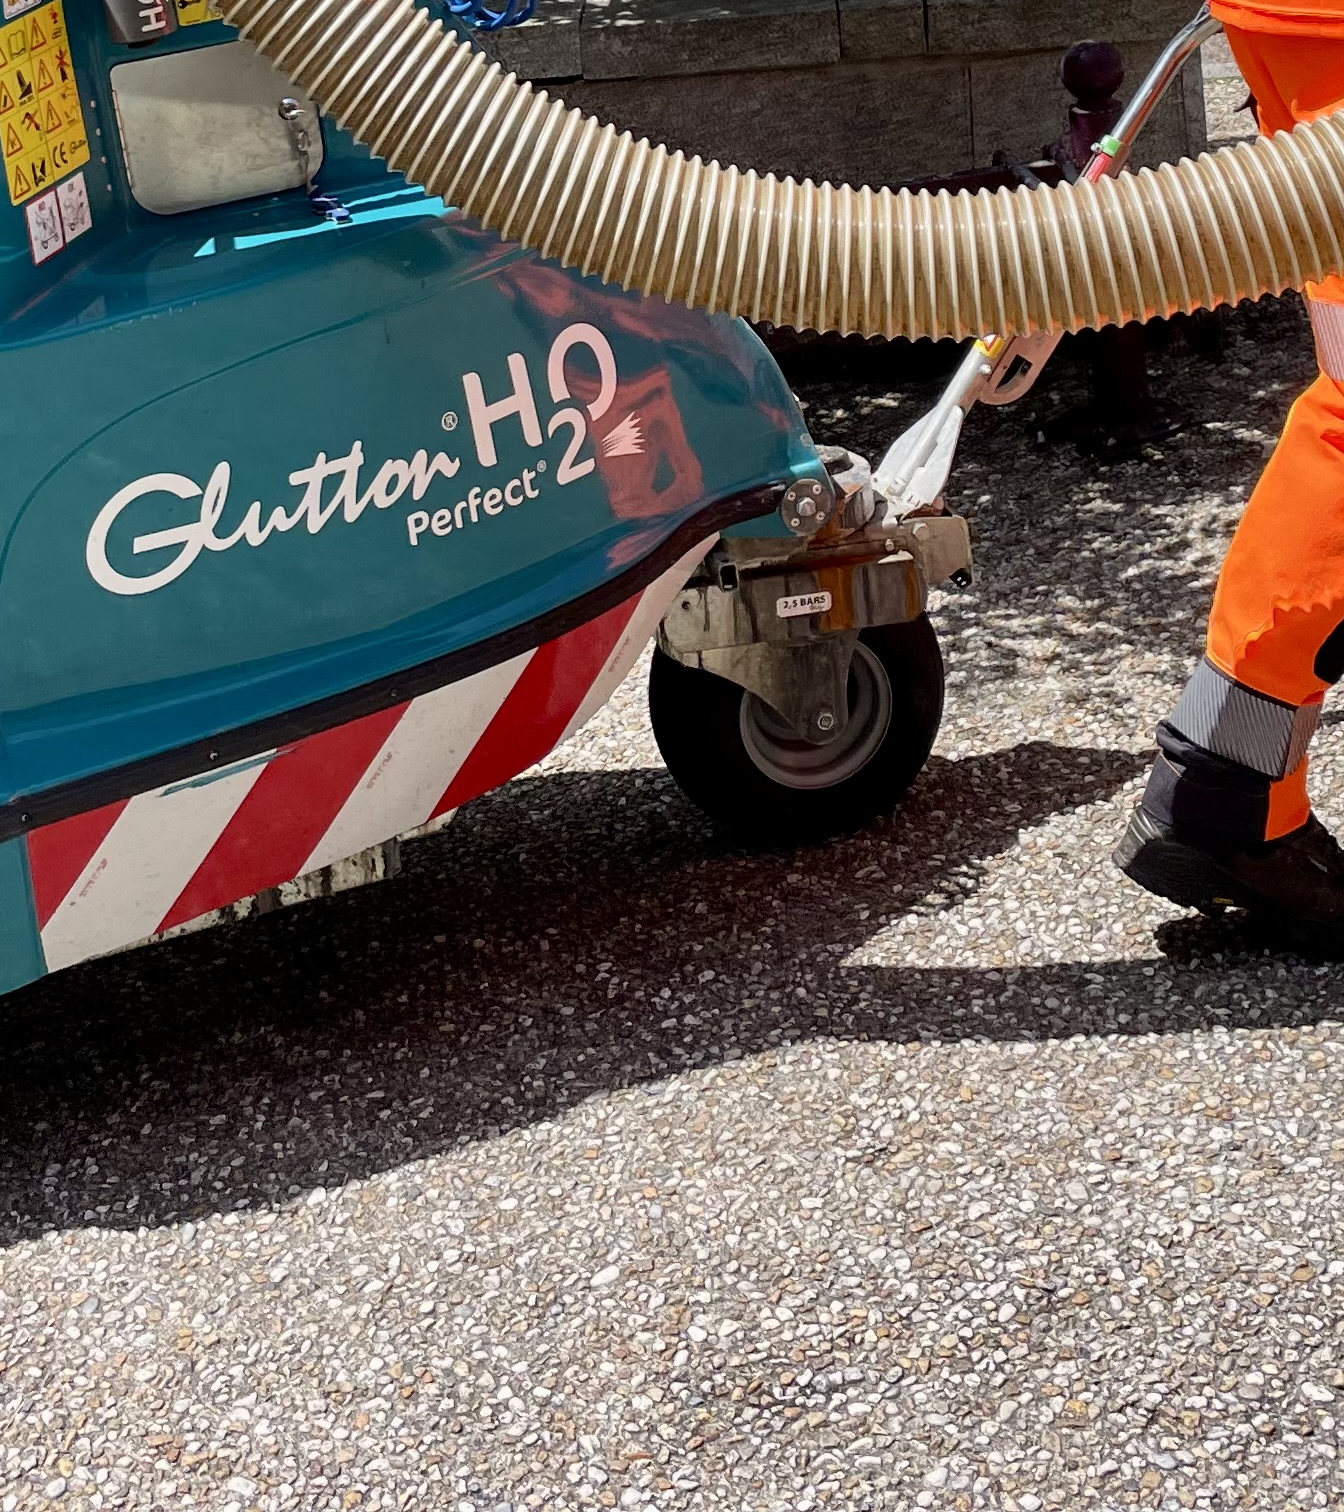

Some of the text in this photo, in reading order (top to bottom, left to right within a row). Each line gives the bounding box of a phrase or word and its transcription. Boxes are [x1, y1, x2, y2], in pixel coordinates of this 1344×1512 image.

[86, 440, 461, 596] Glutton
[406, 471, 539, 546] Perfect
[799, 594, 826, 607] BARS
